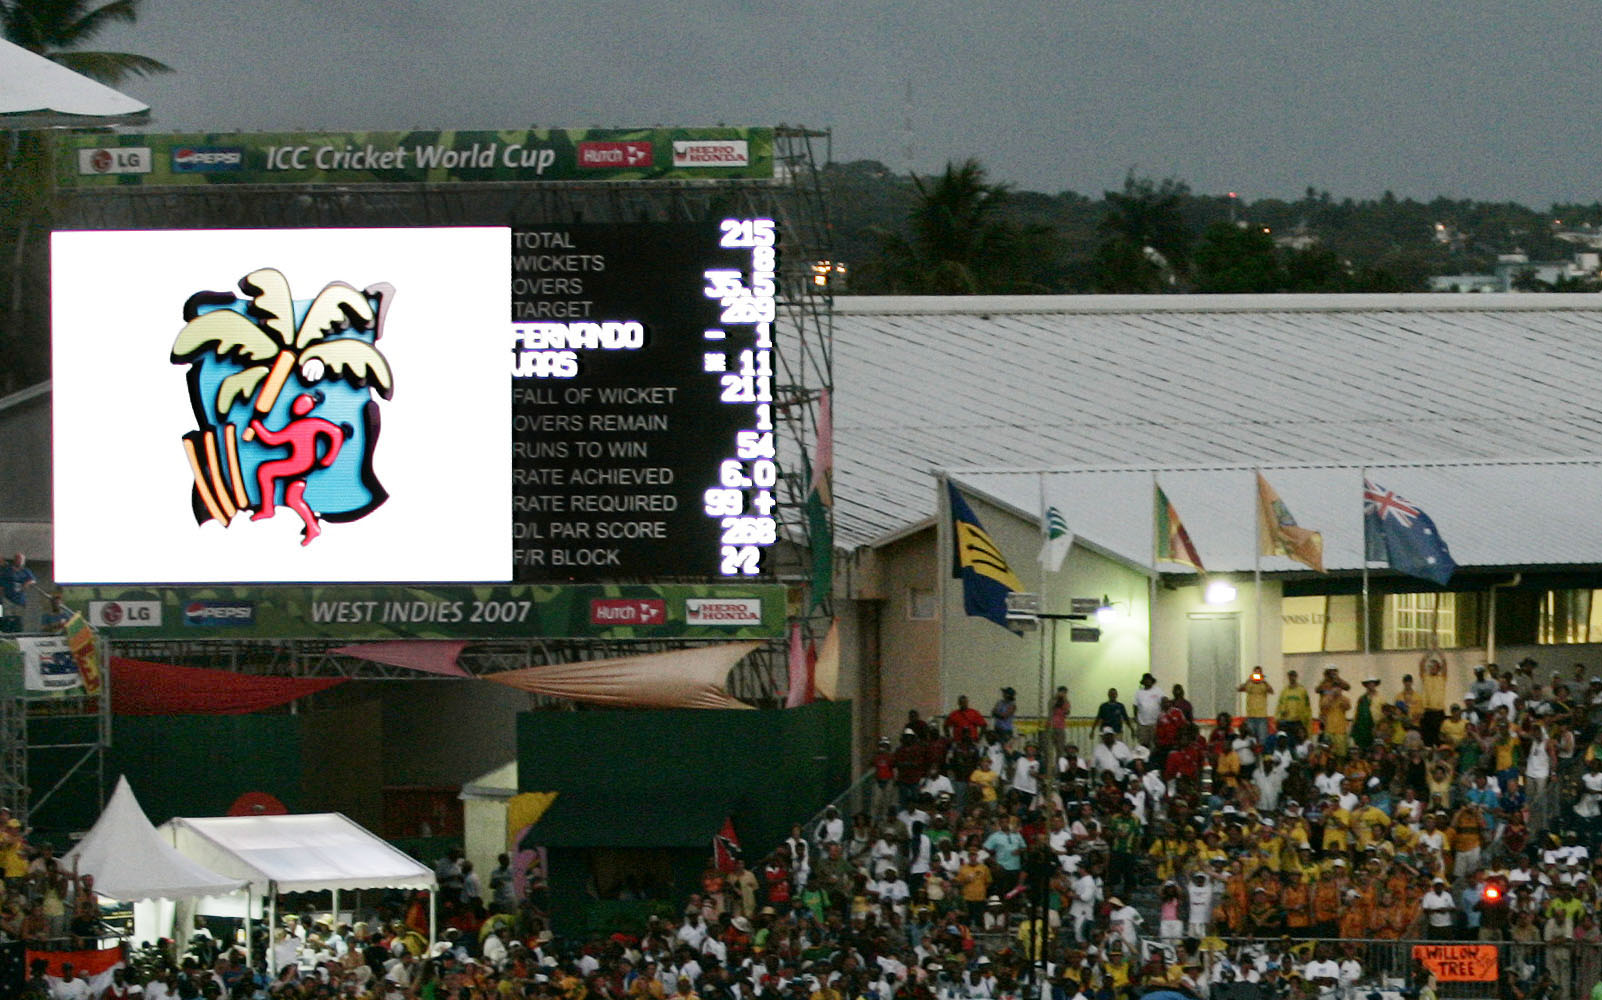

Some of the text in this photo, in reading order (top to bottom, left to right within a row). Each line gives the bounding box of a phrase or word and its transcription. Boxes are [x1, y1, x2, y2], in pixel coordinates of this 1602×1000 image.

[688, 153, 747, 162] HONDA
[689, 145, 736, 154] HERO
[118, 153, 141, 168] LG
[193, 152, 242, 165] PEPSI
[266, 144, 556, 174] ICC Cricket World Cup
[514, 218, 776, 249] TOTAL 215
[513, 246, 776, 272] WICKETS 8
[512, 278, 583, 295] OVERS
[514, 297, 776, 324] TARGET 269
[512, 321, 644, 349] FERNANDO
[513, 388, 558, 405] FALL
[564, 388, 592, 405] OF
[600, 387, 678, 404] WICKET
[513, 403, 773, 431] OVERS REMAIN 1
[513, 430, 776, 460] RUNS TO WIN 54
[513, 458, 777, 488] RATE ACHIEVED 6.0
[513, 496, 564, 512] RATE
[571, 496, 678, 512] REQUIRED
[551, 522, 590, 539] PAR
[596, 522, 667, 539] SCORE
[552, 549, 621, 566] BLOCK
[127, 606, 151, 621] LG
[203, 606, 252, 619] PEPSI
[311, 600, 532, 623] WEST INDIES 2007
[701, 611, 759, 620] HONDA
[702, 604, 748, 612] HERO
[1425, 946, 1480, 961] WILLOW
[1438, 961, 1475, 976] TREE
